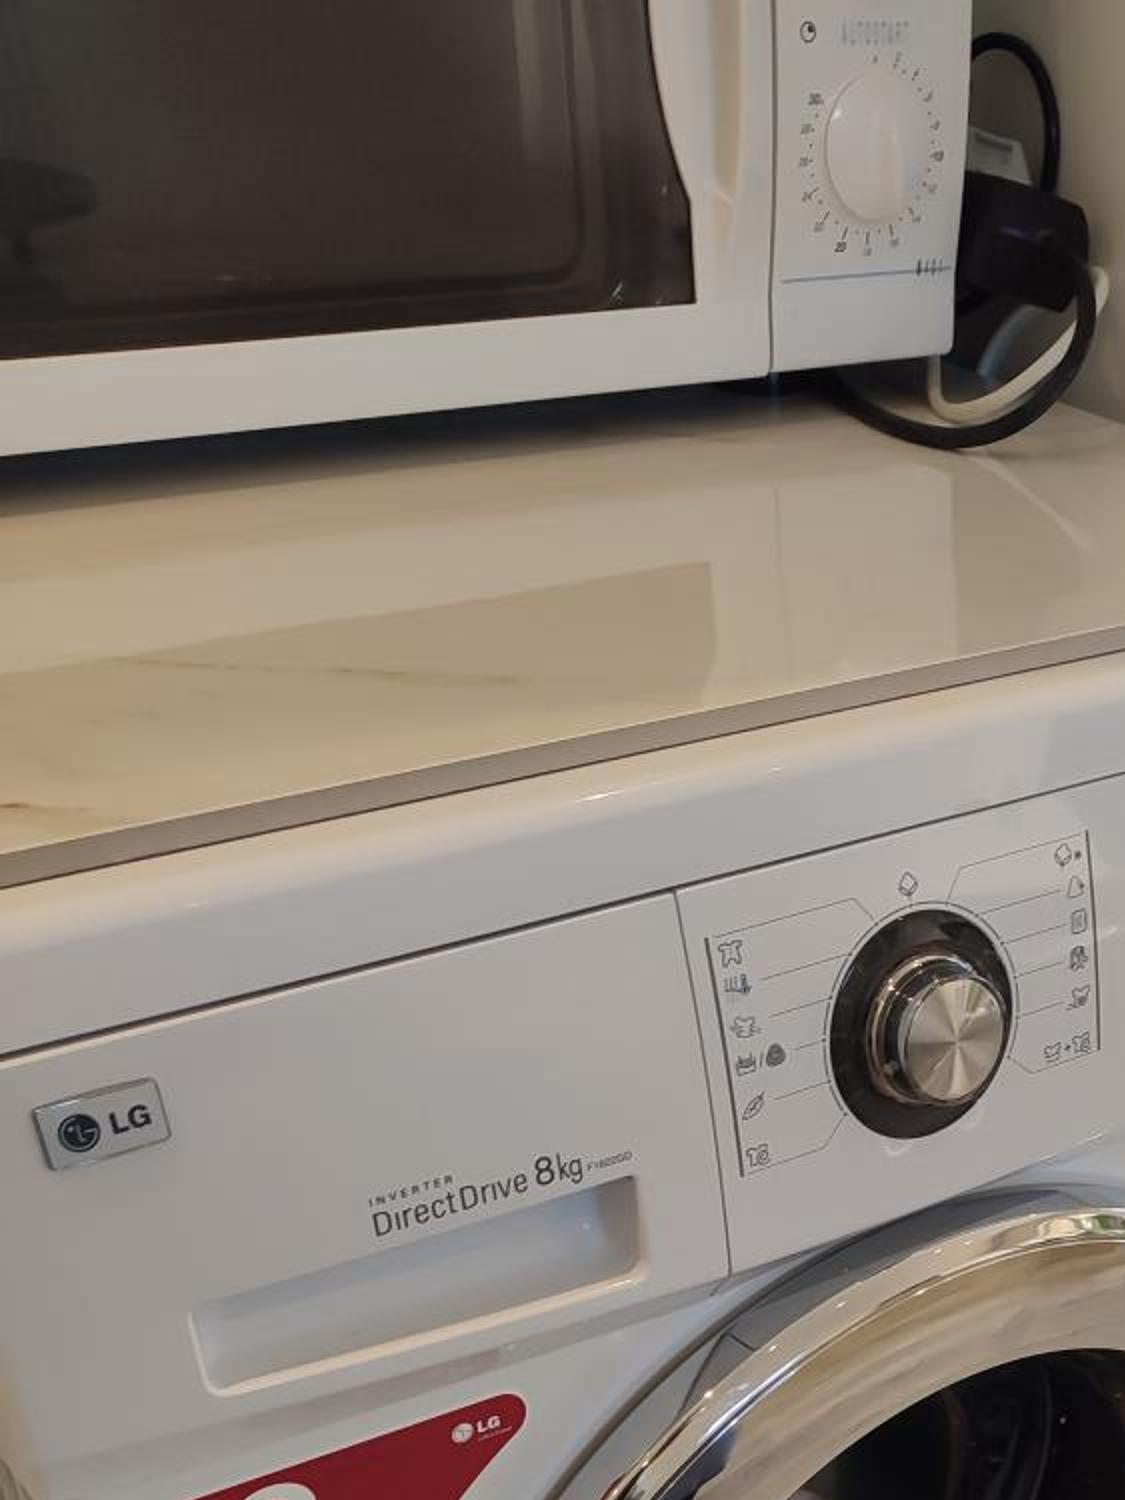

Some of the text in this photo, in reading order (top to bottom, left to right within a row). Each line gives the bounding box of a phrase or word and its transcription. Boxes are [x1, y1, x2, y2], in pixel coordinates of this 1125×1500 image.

[109, 1104, 152, 1135] LG
[368, 1174, 453, 1207] INVERTER
[477, 1415, 501, 1433] LG
